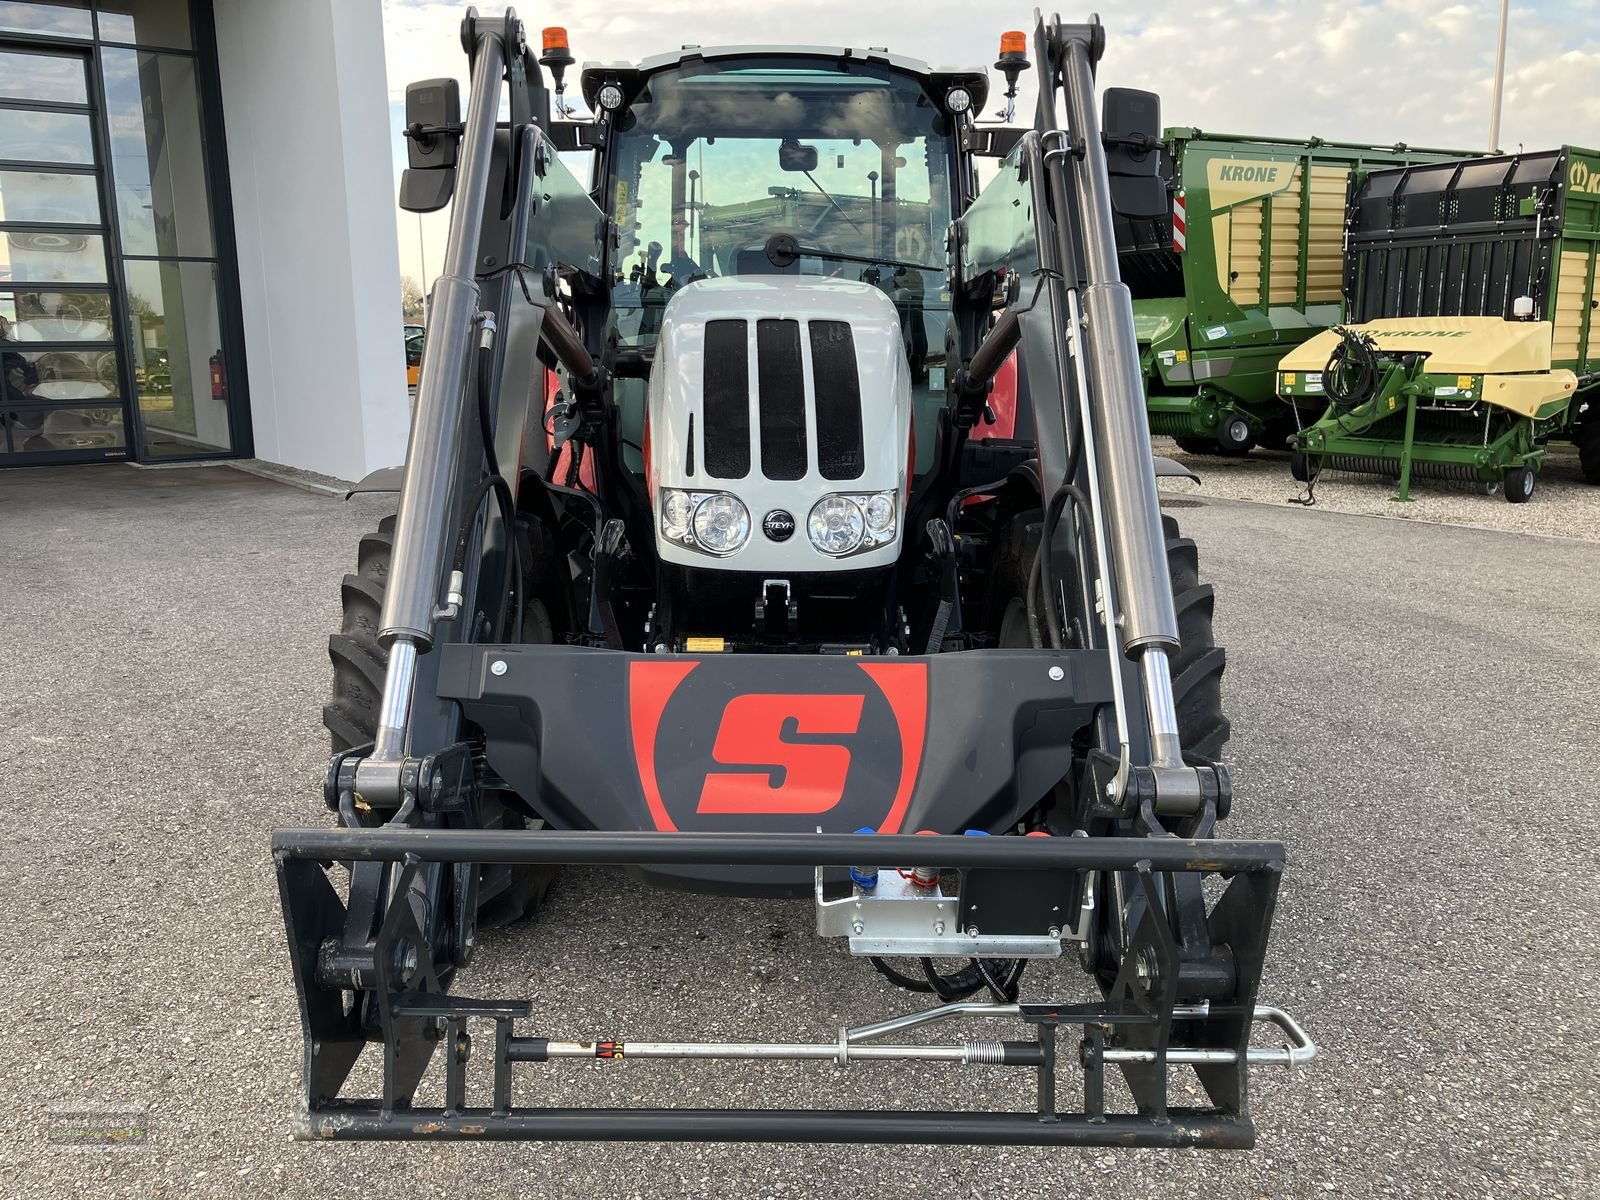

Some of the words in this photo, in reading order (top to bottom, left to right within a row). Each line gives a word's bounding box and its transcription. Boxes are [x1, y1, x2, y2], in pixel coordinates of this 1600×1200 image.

[1220, 165, 1278, 182] KRONE
[1374, 330, 1473, 338] KRONE
[763, 521, 794, 529] STEYR
[696, 694, 865, 814] S
